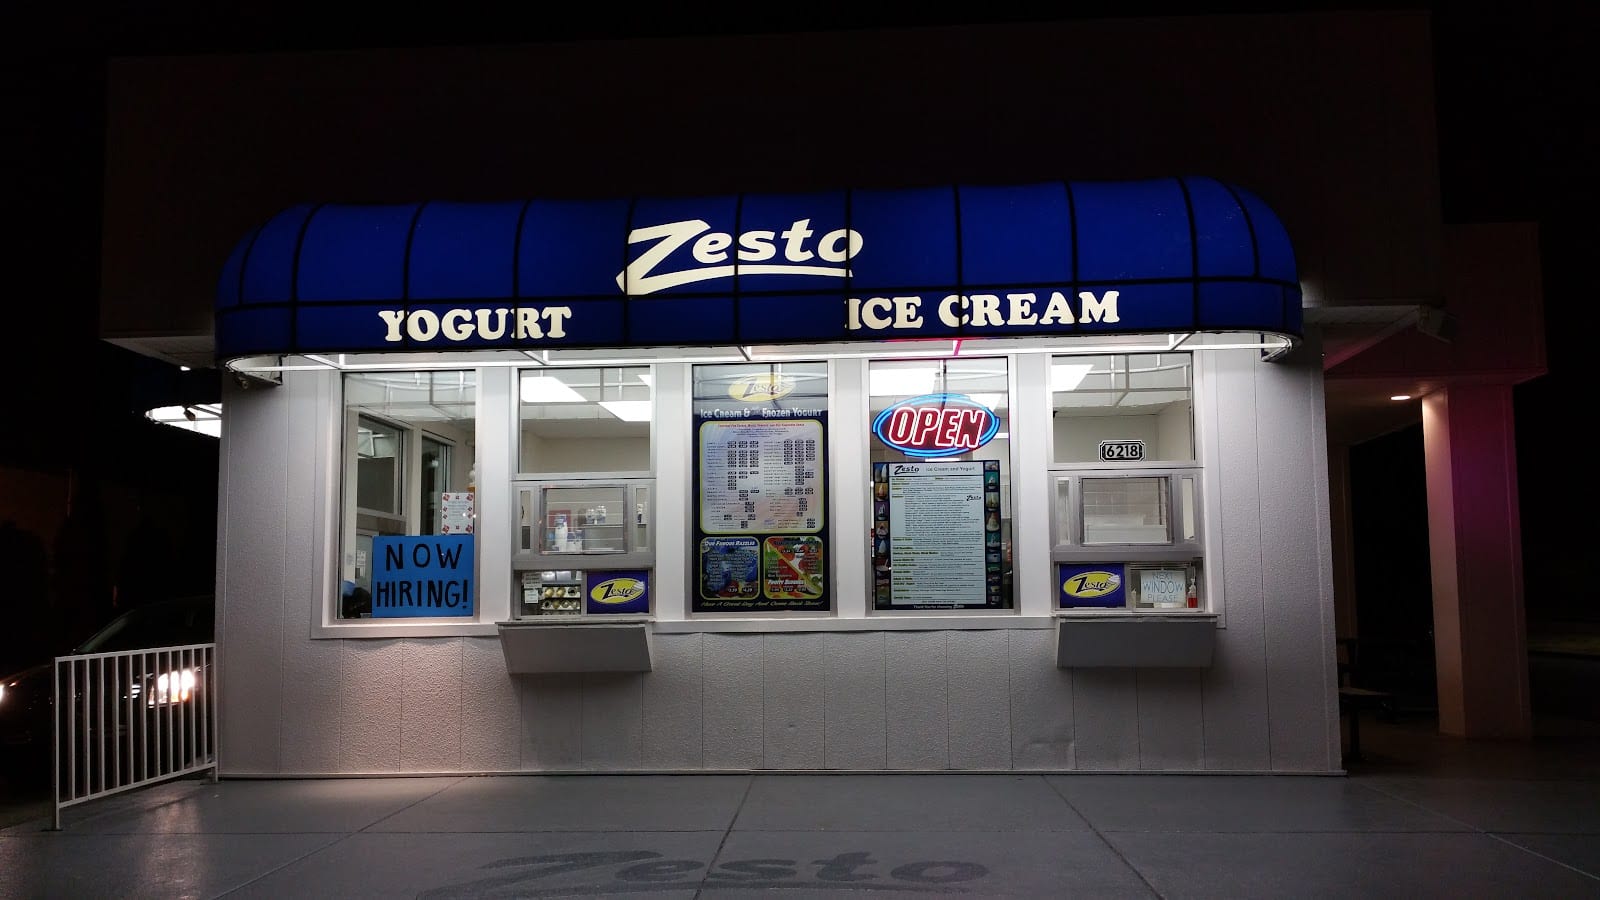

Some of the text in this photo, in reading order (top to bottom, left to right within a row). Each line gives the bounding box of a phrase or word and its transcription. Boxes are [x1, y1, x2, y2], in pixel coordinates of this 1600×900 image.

[615, 218, 864, 296] Zesto
[378, 306, 572, 342] YOGURT
[845, 290, 1120, 330] ICE CREAM
[700, 408, 712, 418] Ice
[888, 406, 985, 448] OPEN
[1106, 445, 1138, 458] 6218
[894, 464, 920, 475] Zesto
[385, 543, 463, 571] NOW
[376, 579, 468, 609] HIRING!
[600, 583, 632, 600] Zesto
[1073, 576, 1107, 594] Zesto
[1143, 580, 1184, 594] WINDOW
[414, 850, 990, 900] Zesto
